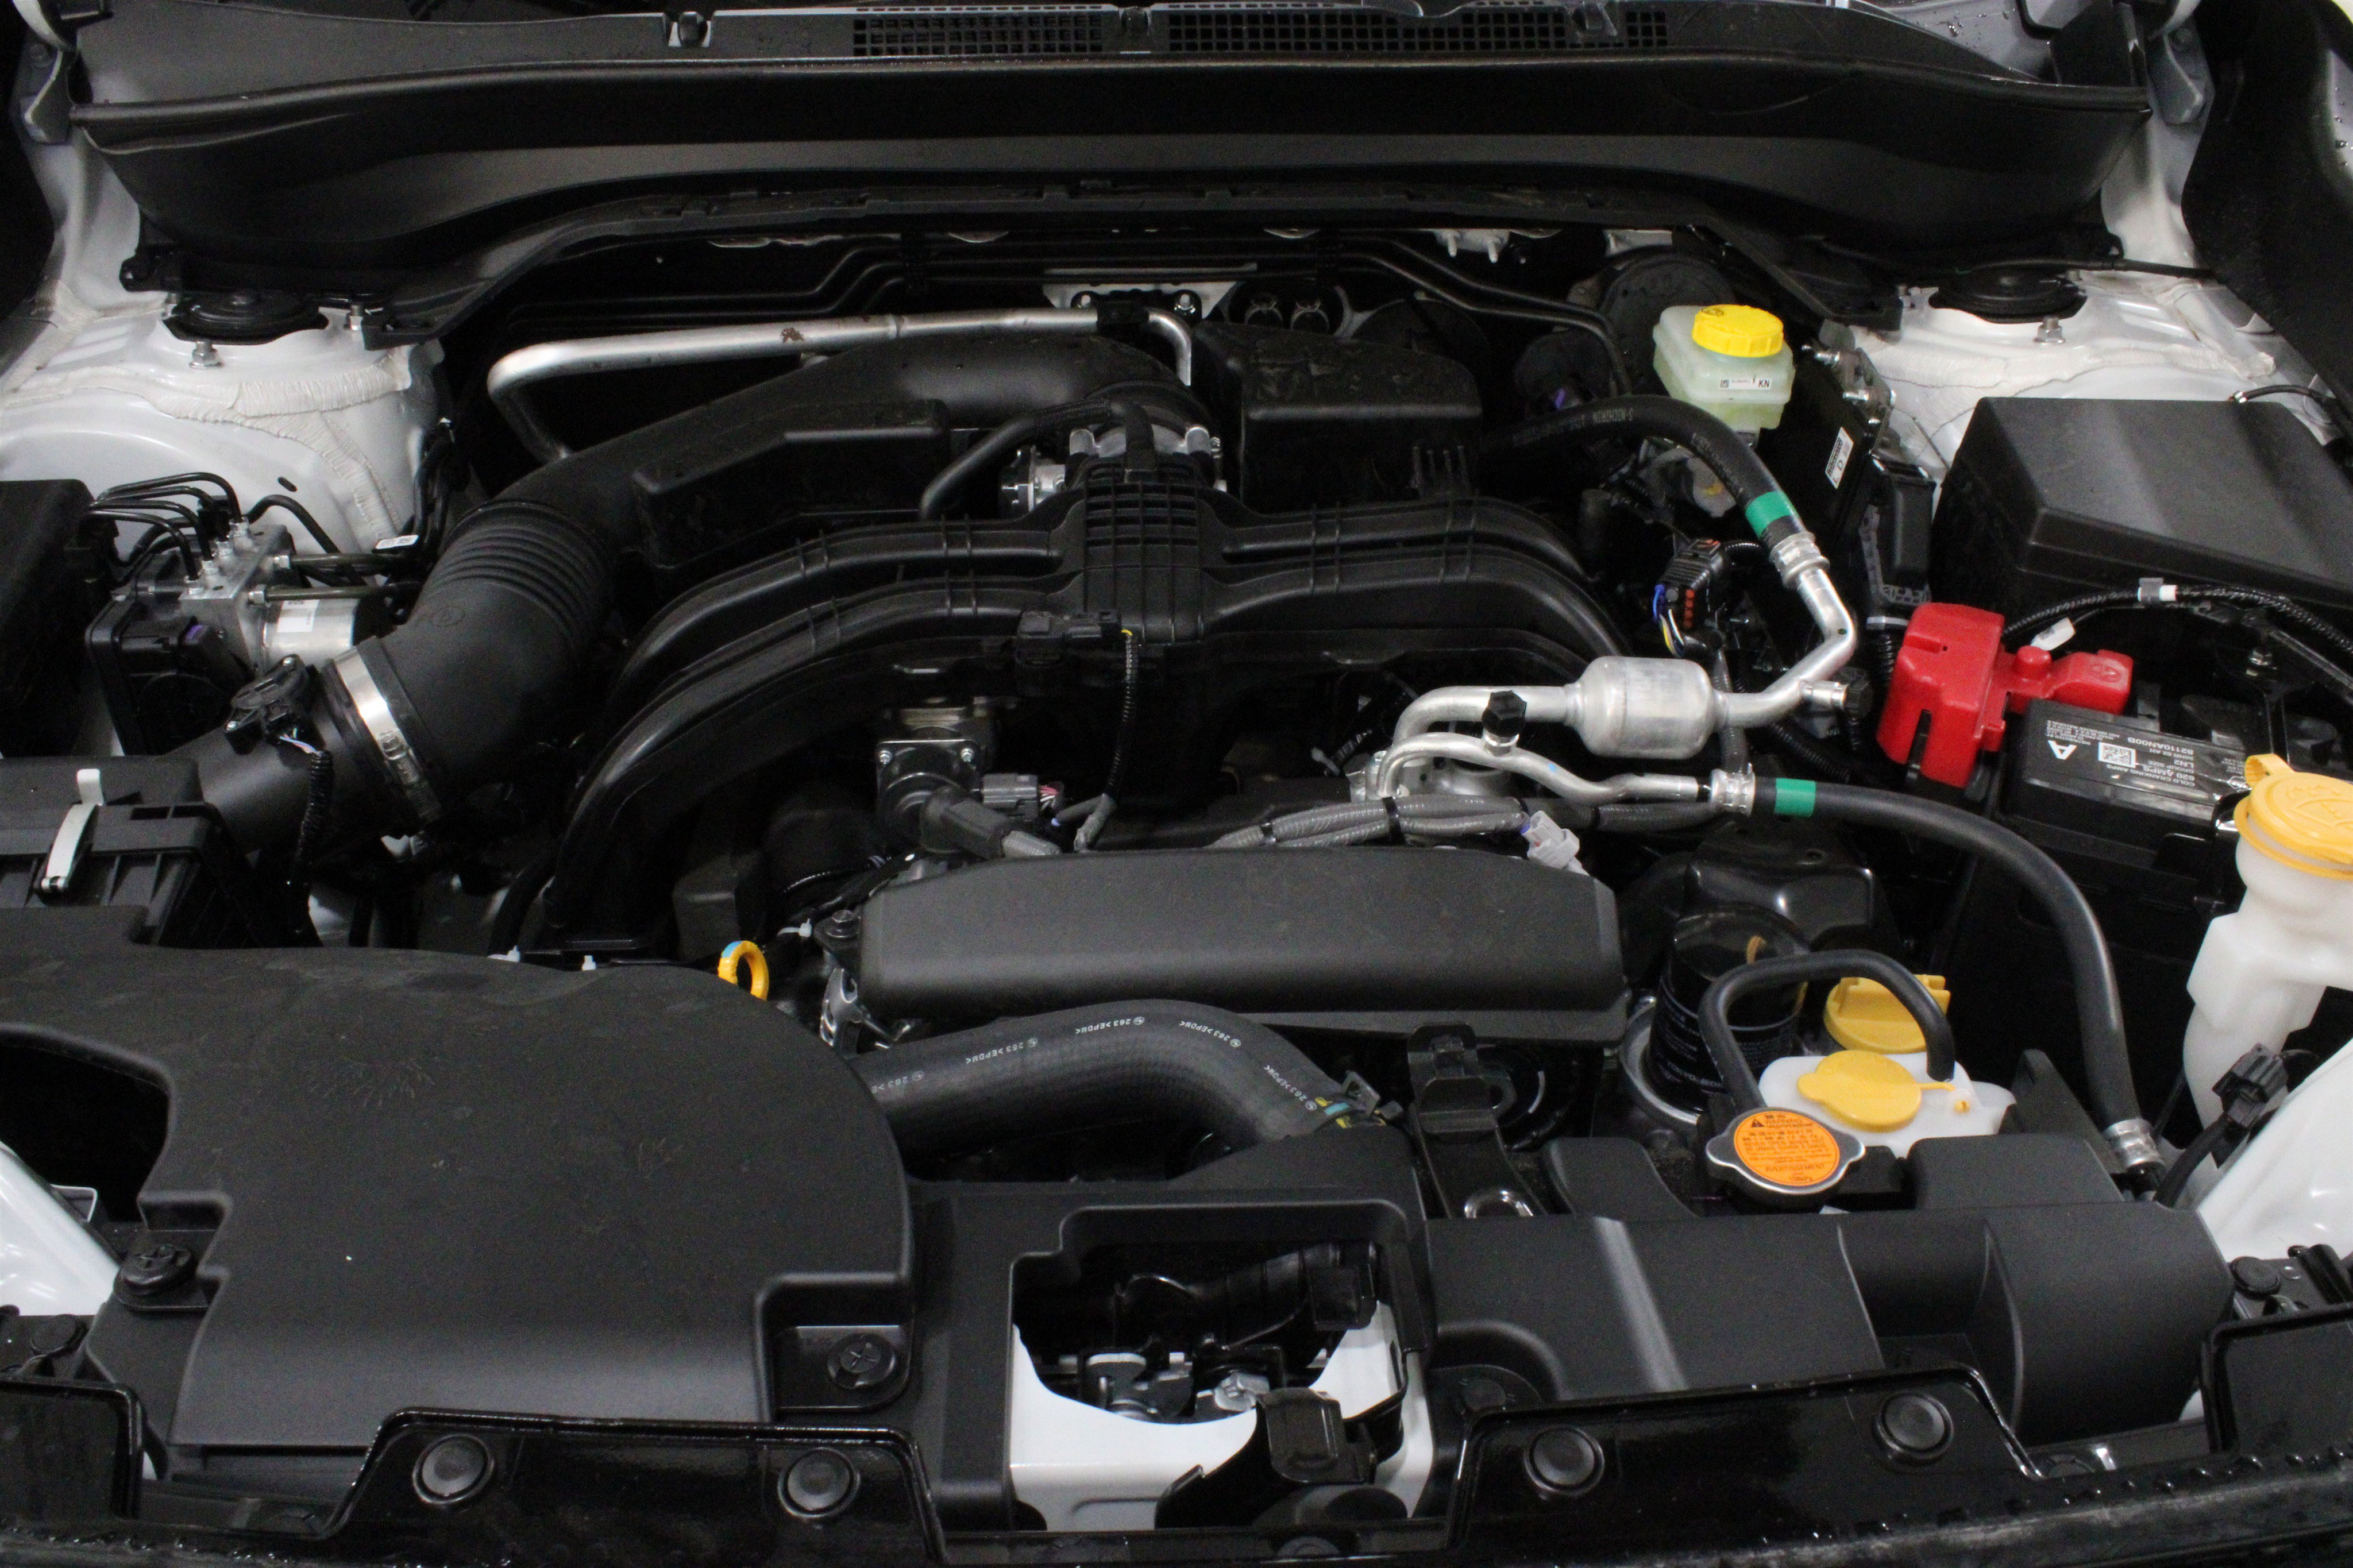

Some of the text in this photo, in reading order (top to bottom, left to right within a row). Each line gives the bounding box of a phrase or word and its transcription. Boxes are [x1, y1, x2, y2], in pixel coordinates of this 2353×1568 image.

[1758, 379, 1770, 388] KN
[2127, 736, 2194, 755] 82110AN00B
[2166, 764, 2195, 774] GROUP
[2173, 759, 2194, 768] LN2
[2106, 763, 2196, 787] COLD CRANKING AMPS
[2142, 764, 2195, 782] 620 AMPS
[1113, 1018, 1132, 1027] 263
[1213, 1030, 1230, 1041] 263
[1005, 1042, 1024, 1053] 263
[1289, 1087, 1307, 1102] 263
